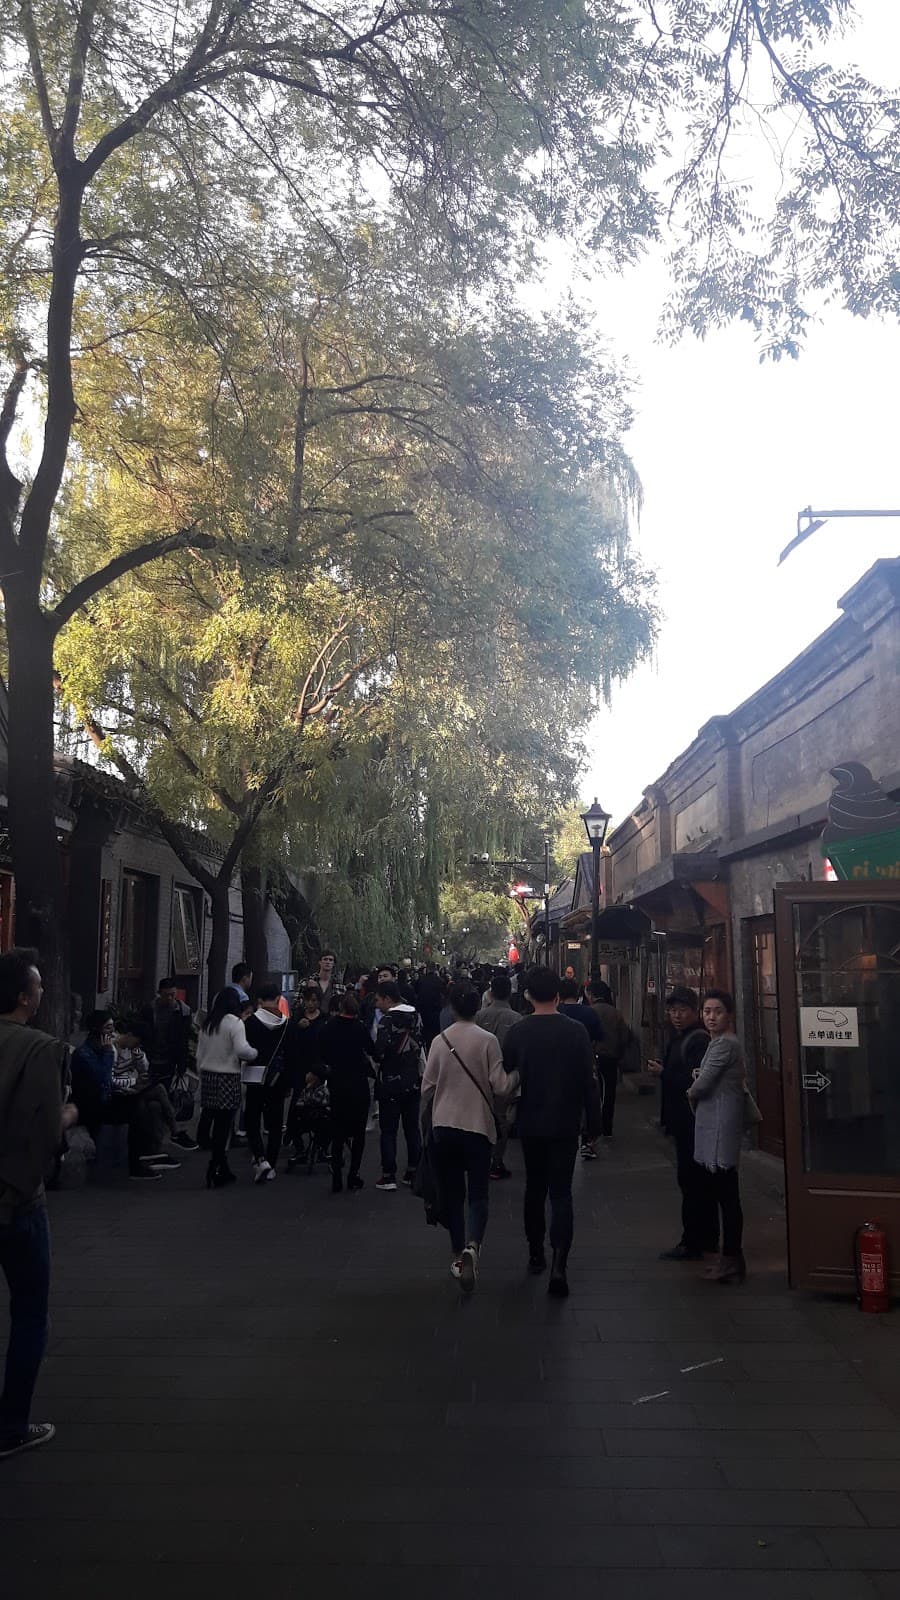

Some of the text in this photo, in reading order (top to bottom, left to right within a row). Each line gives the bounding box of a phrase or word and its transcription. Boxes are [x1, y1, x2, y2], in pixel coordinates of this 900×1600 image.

[808, 1030, 853, 1040] 点单请往里
